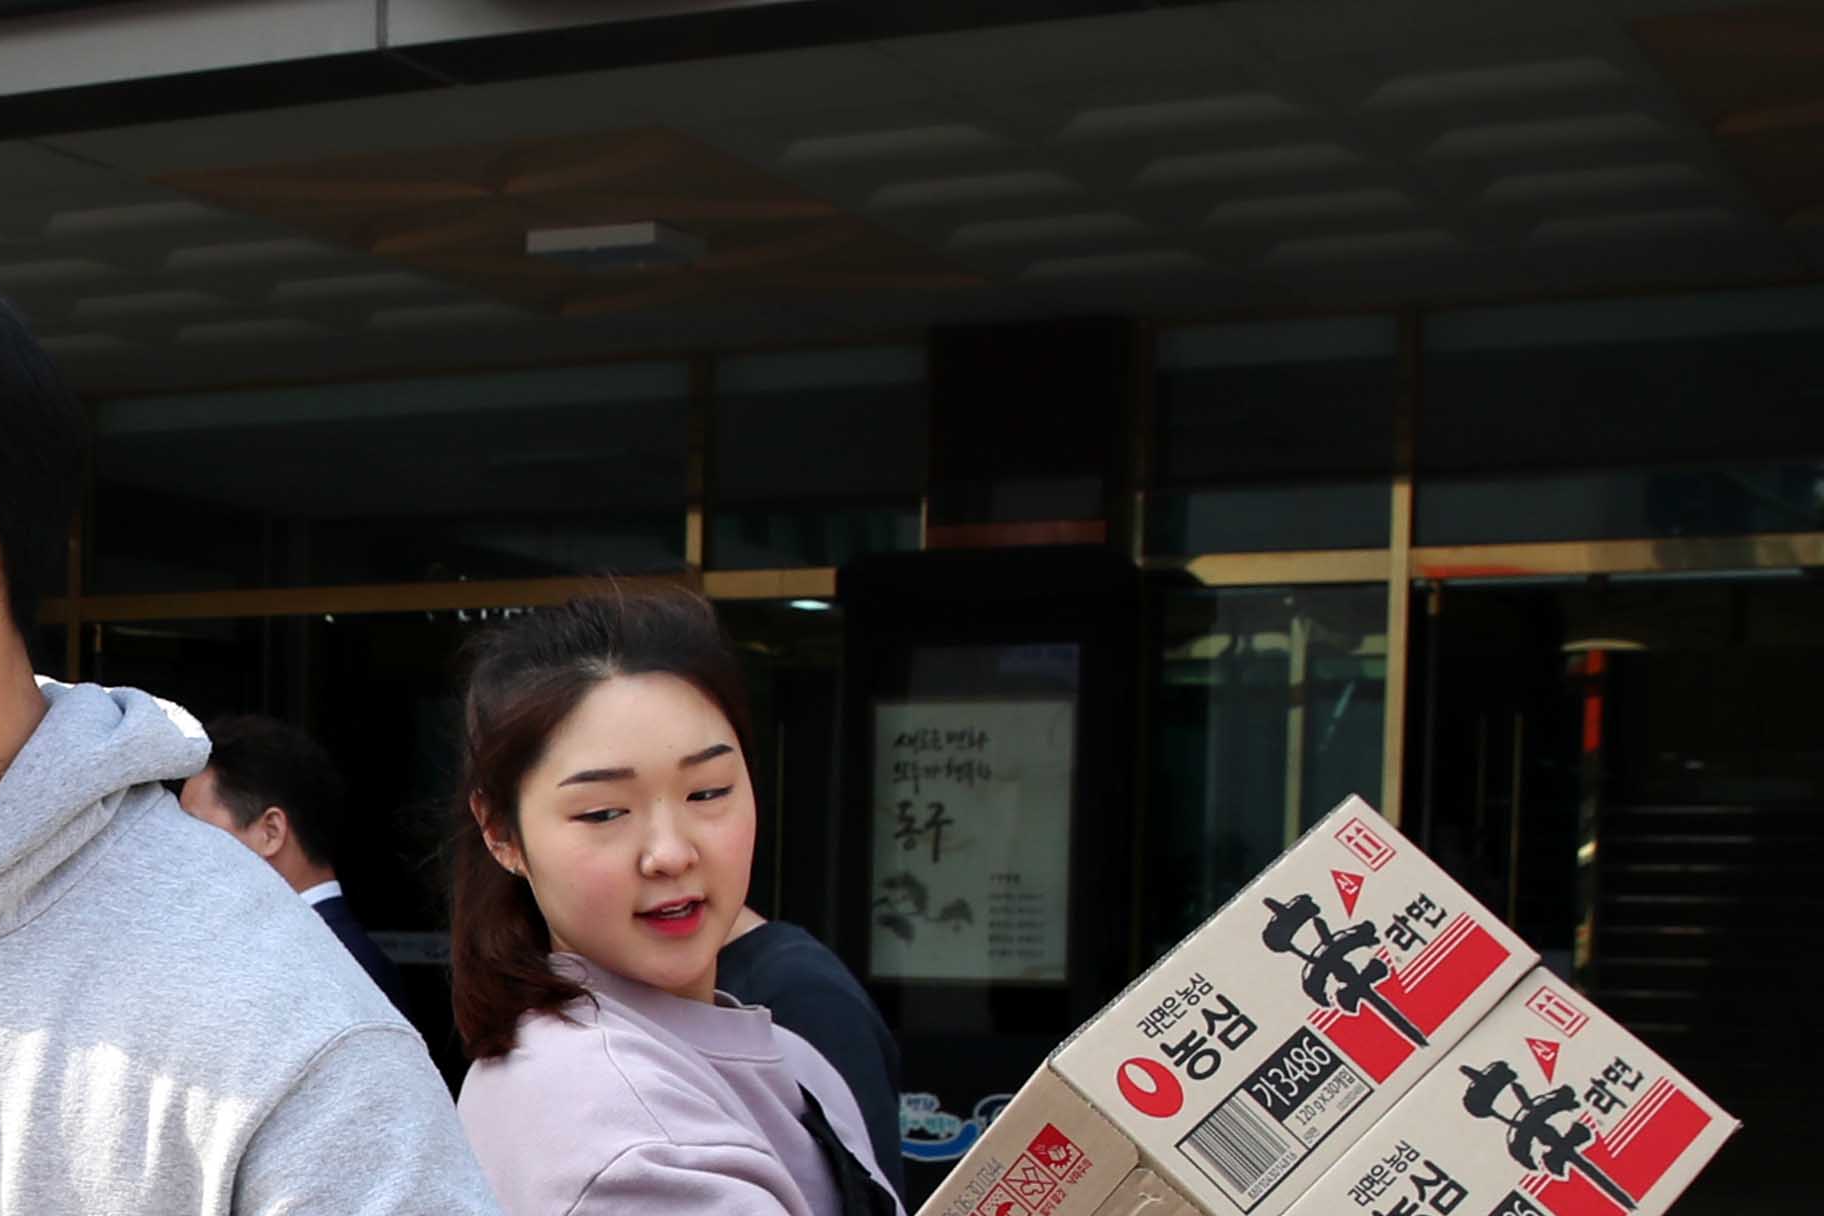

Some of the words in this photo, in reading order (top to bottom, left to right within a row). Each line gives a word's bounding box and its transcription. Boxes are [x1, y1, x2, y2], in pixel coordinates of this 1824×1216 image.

[894, 799, 954, 864] 동구
[1383, 892, 1448, 953] 라면
[1262, 892, 1430, 1047] 辛
[1137, 996, 1187, 1039] 라면은
[1175, 972, 1213, 1007] 농심
[1160, 994, 1258, 1080] 농심
[1252, 1036, 1331, 1107] 가3486
[1583, 1055, 1645, 1116] 라면
[1295, 1104, 1316, 1126] 120
[1462, 1060, 1638, 1212] 辛
[1348, 1164, 1396, 1207] 라면은
[1385, 1140, 1420, 1173] 농심
